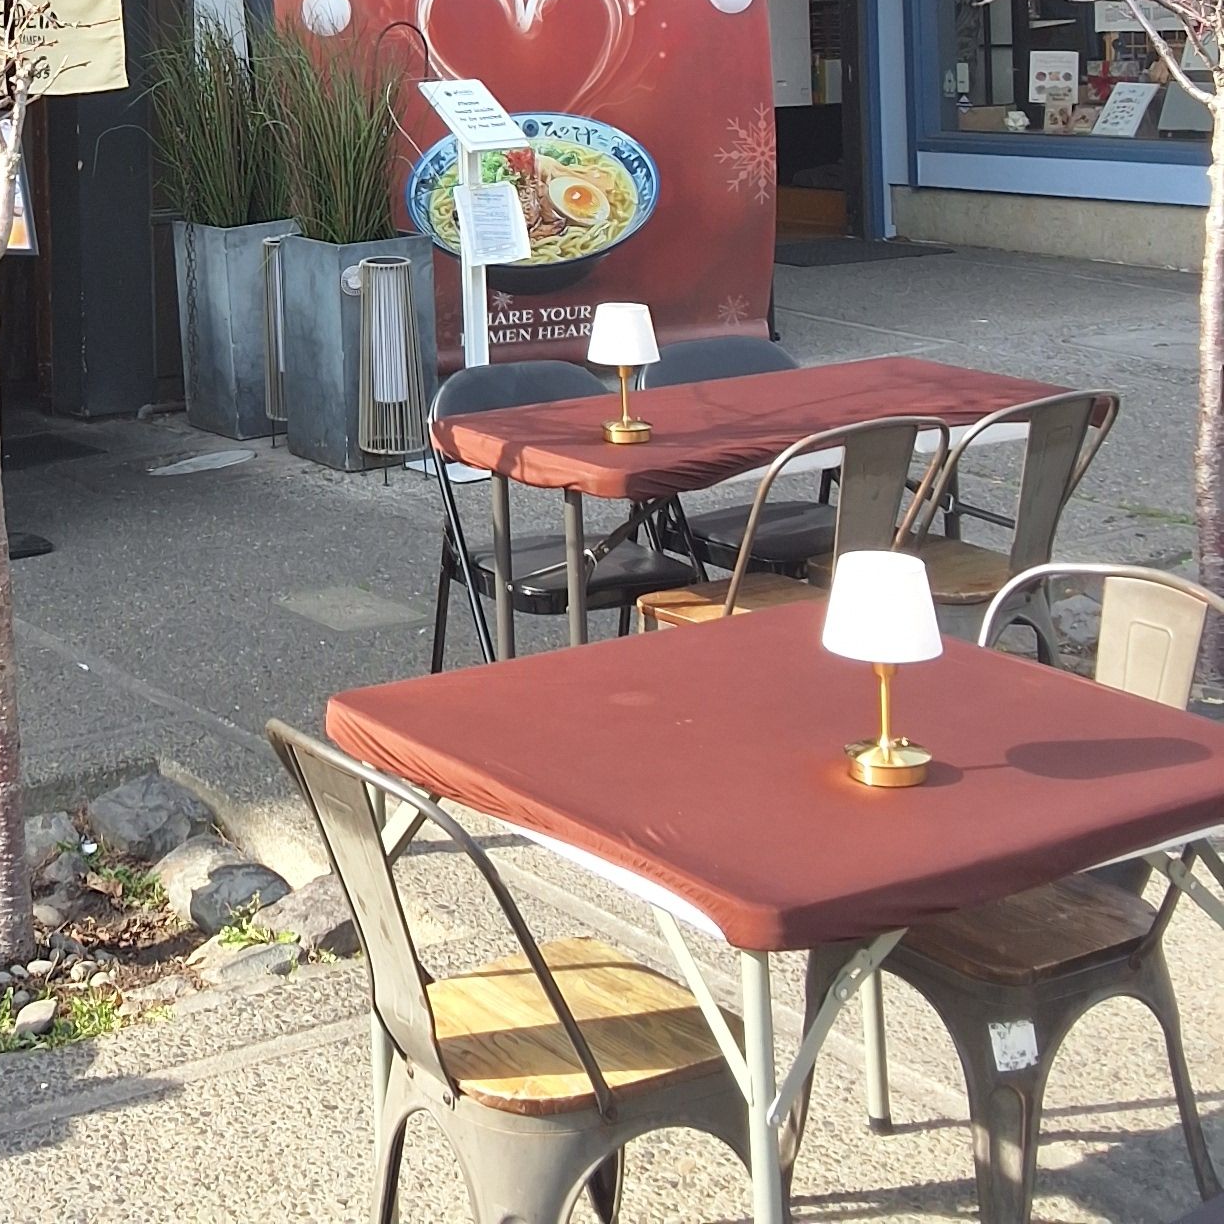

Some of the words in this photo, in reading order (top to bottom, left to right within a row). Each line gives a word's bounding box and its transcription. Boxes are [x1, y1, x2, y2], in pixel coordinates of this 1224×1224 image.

[487, 309, 534, 326] ARE
[539, 305, 592, 323] YOUR
[537, 322, 594, 340] HEAR
